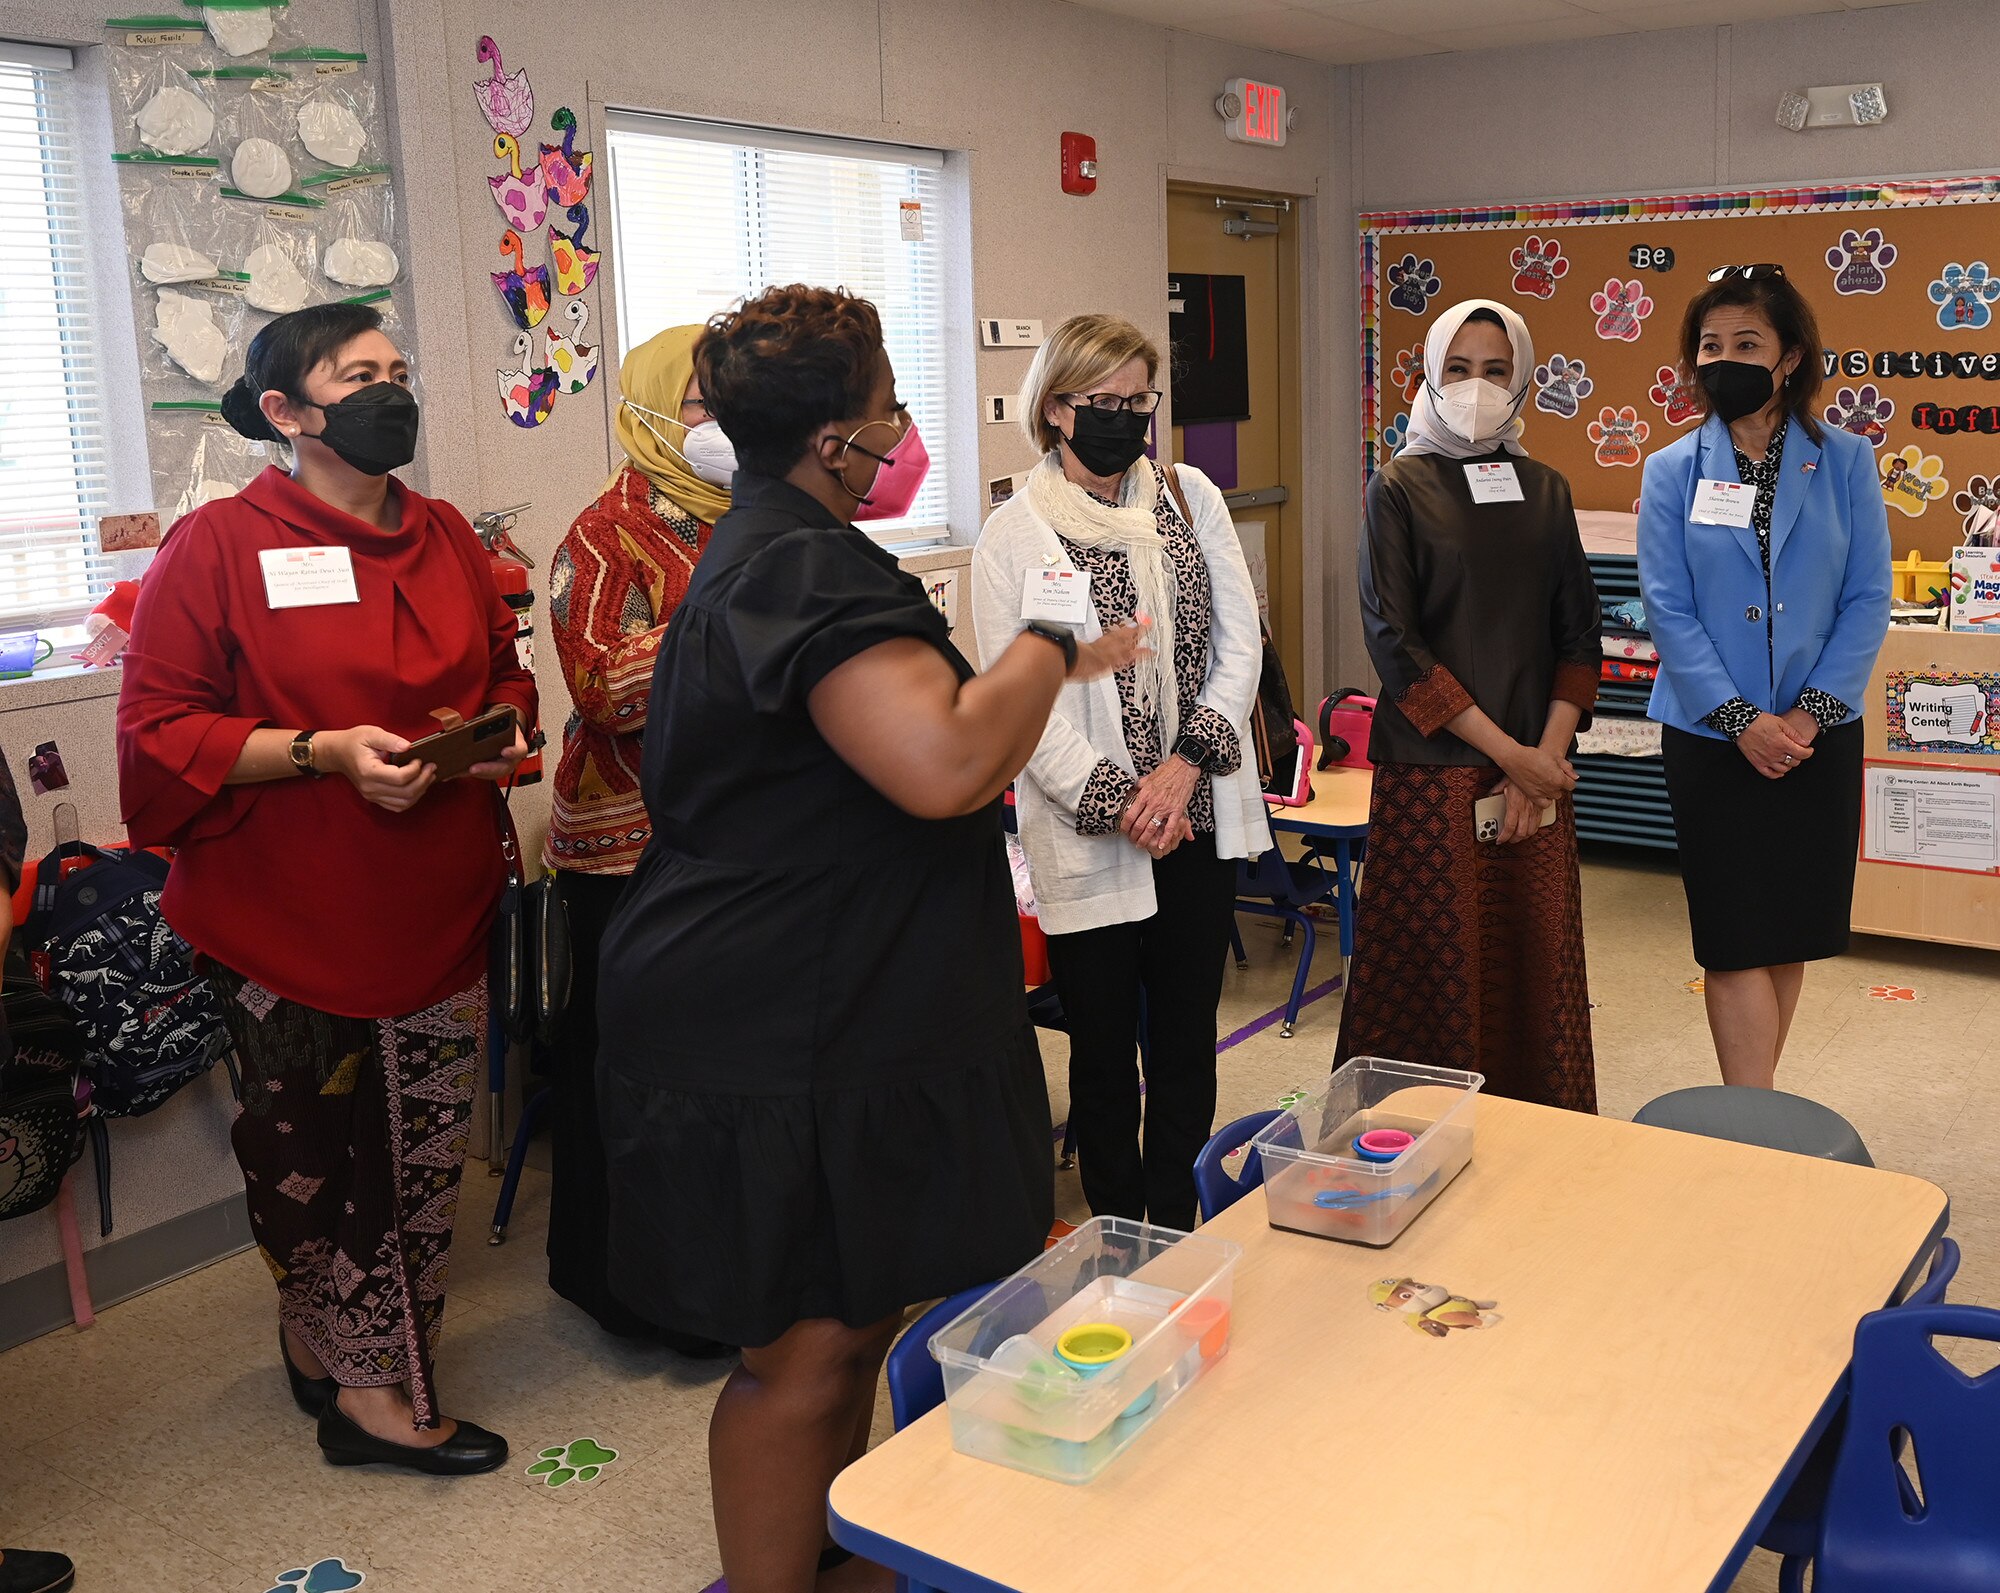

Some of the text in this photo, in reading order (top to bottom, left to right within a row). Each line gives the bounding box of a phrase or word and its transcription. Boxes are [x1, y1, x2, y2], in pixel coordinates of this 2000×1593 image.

[1246, 83, 1280, 141] EXIT
[1516, 258, 1552, 272] do your
[1635, 248, 1666, 268] Be
[1408, 265, 1431, 280] Keep
[1848, 264, 1874, 274] Plan
[1841, 273, 1880, 285] ahead.
[1403, 293, 1422, 305] tidy.
[1672, 402, 1688, 410] up.
[1845, 401, 1877, 413] Think
[1838, 412, 1886, 428] positive.
[1903, 470, 1934, 494] Work
[1978, 486, 1993, 496] Be
[86, 633, 112, 659] SPRITZ
[1909, 701, 1953, 715] Writing
[1911, 716, 1952, 727] Center
[14, 1046, 72, 1072] Kitty
